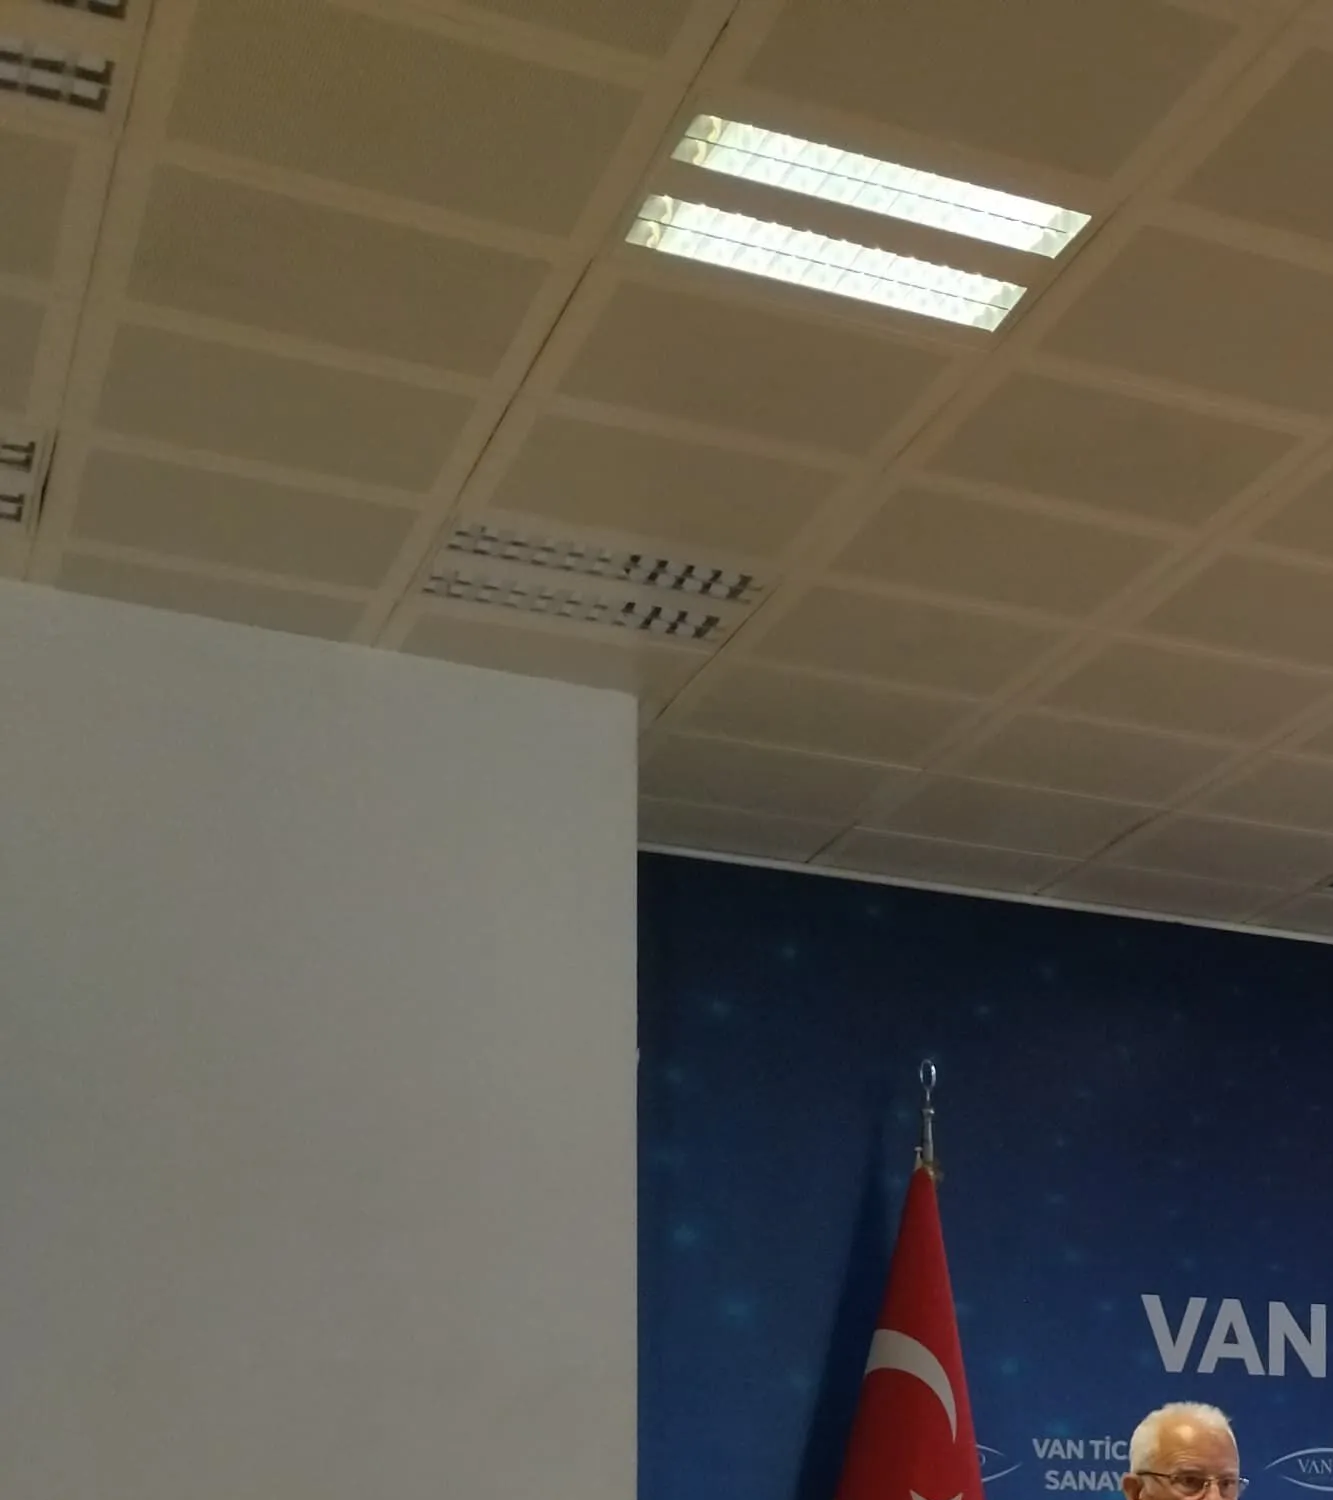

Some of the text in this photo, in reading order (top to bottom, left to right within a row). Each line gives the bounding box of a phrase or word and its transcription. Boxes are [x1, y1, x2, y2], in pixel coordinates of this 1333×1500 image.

[1141, 1294, 1327, 1378] VAN
[1032, 1438, 1085, 1460] VAN
[1297, 1458, 1333, 1475] VAN
[1044, 1470, 1123, 1491] SANAY
